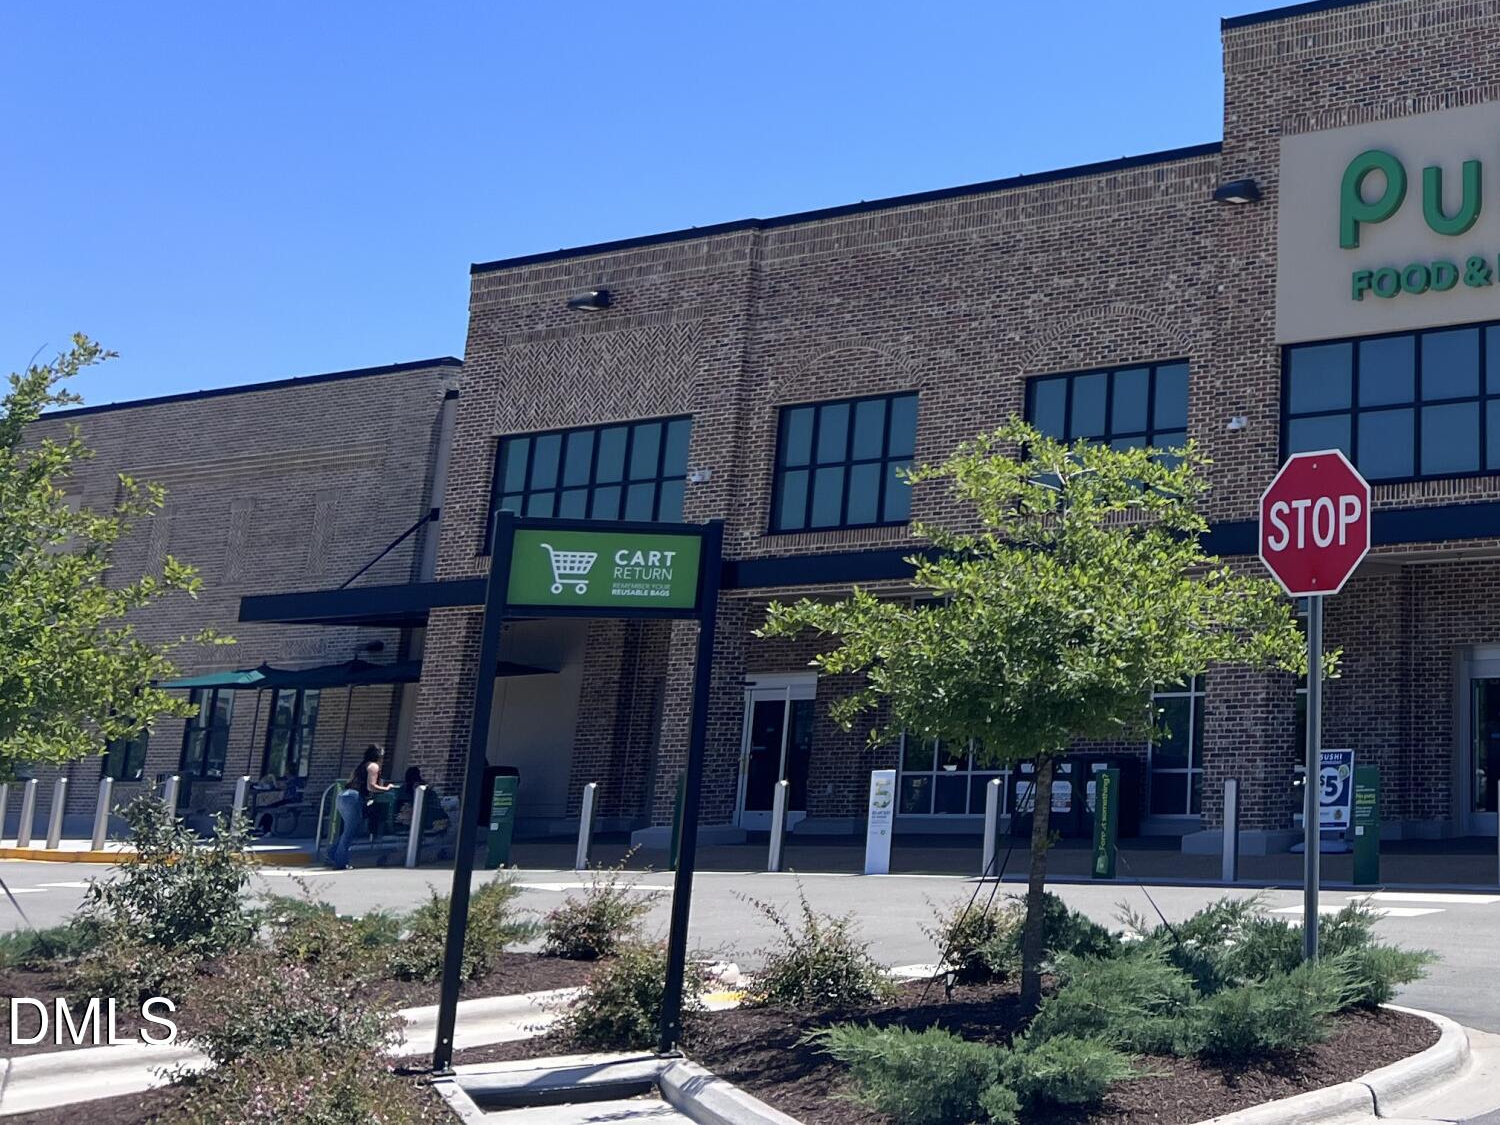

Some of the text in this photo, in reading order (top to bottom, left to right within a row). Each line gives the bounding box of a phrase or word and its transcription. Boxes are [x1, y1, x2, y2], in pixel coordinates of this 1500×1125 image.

[1351, 260, 1459, 302] FOOD
[1463, 255, 1493, 287] &
[1267, 494, 1362, 552] STOP
[614, 549, 677, 567] CART
[613, 566, 673, 581] RETURN
[611, 588, 670, 597] REUSABLE BAGS
